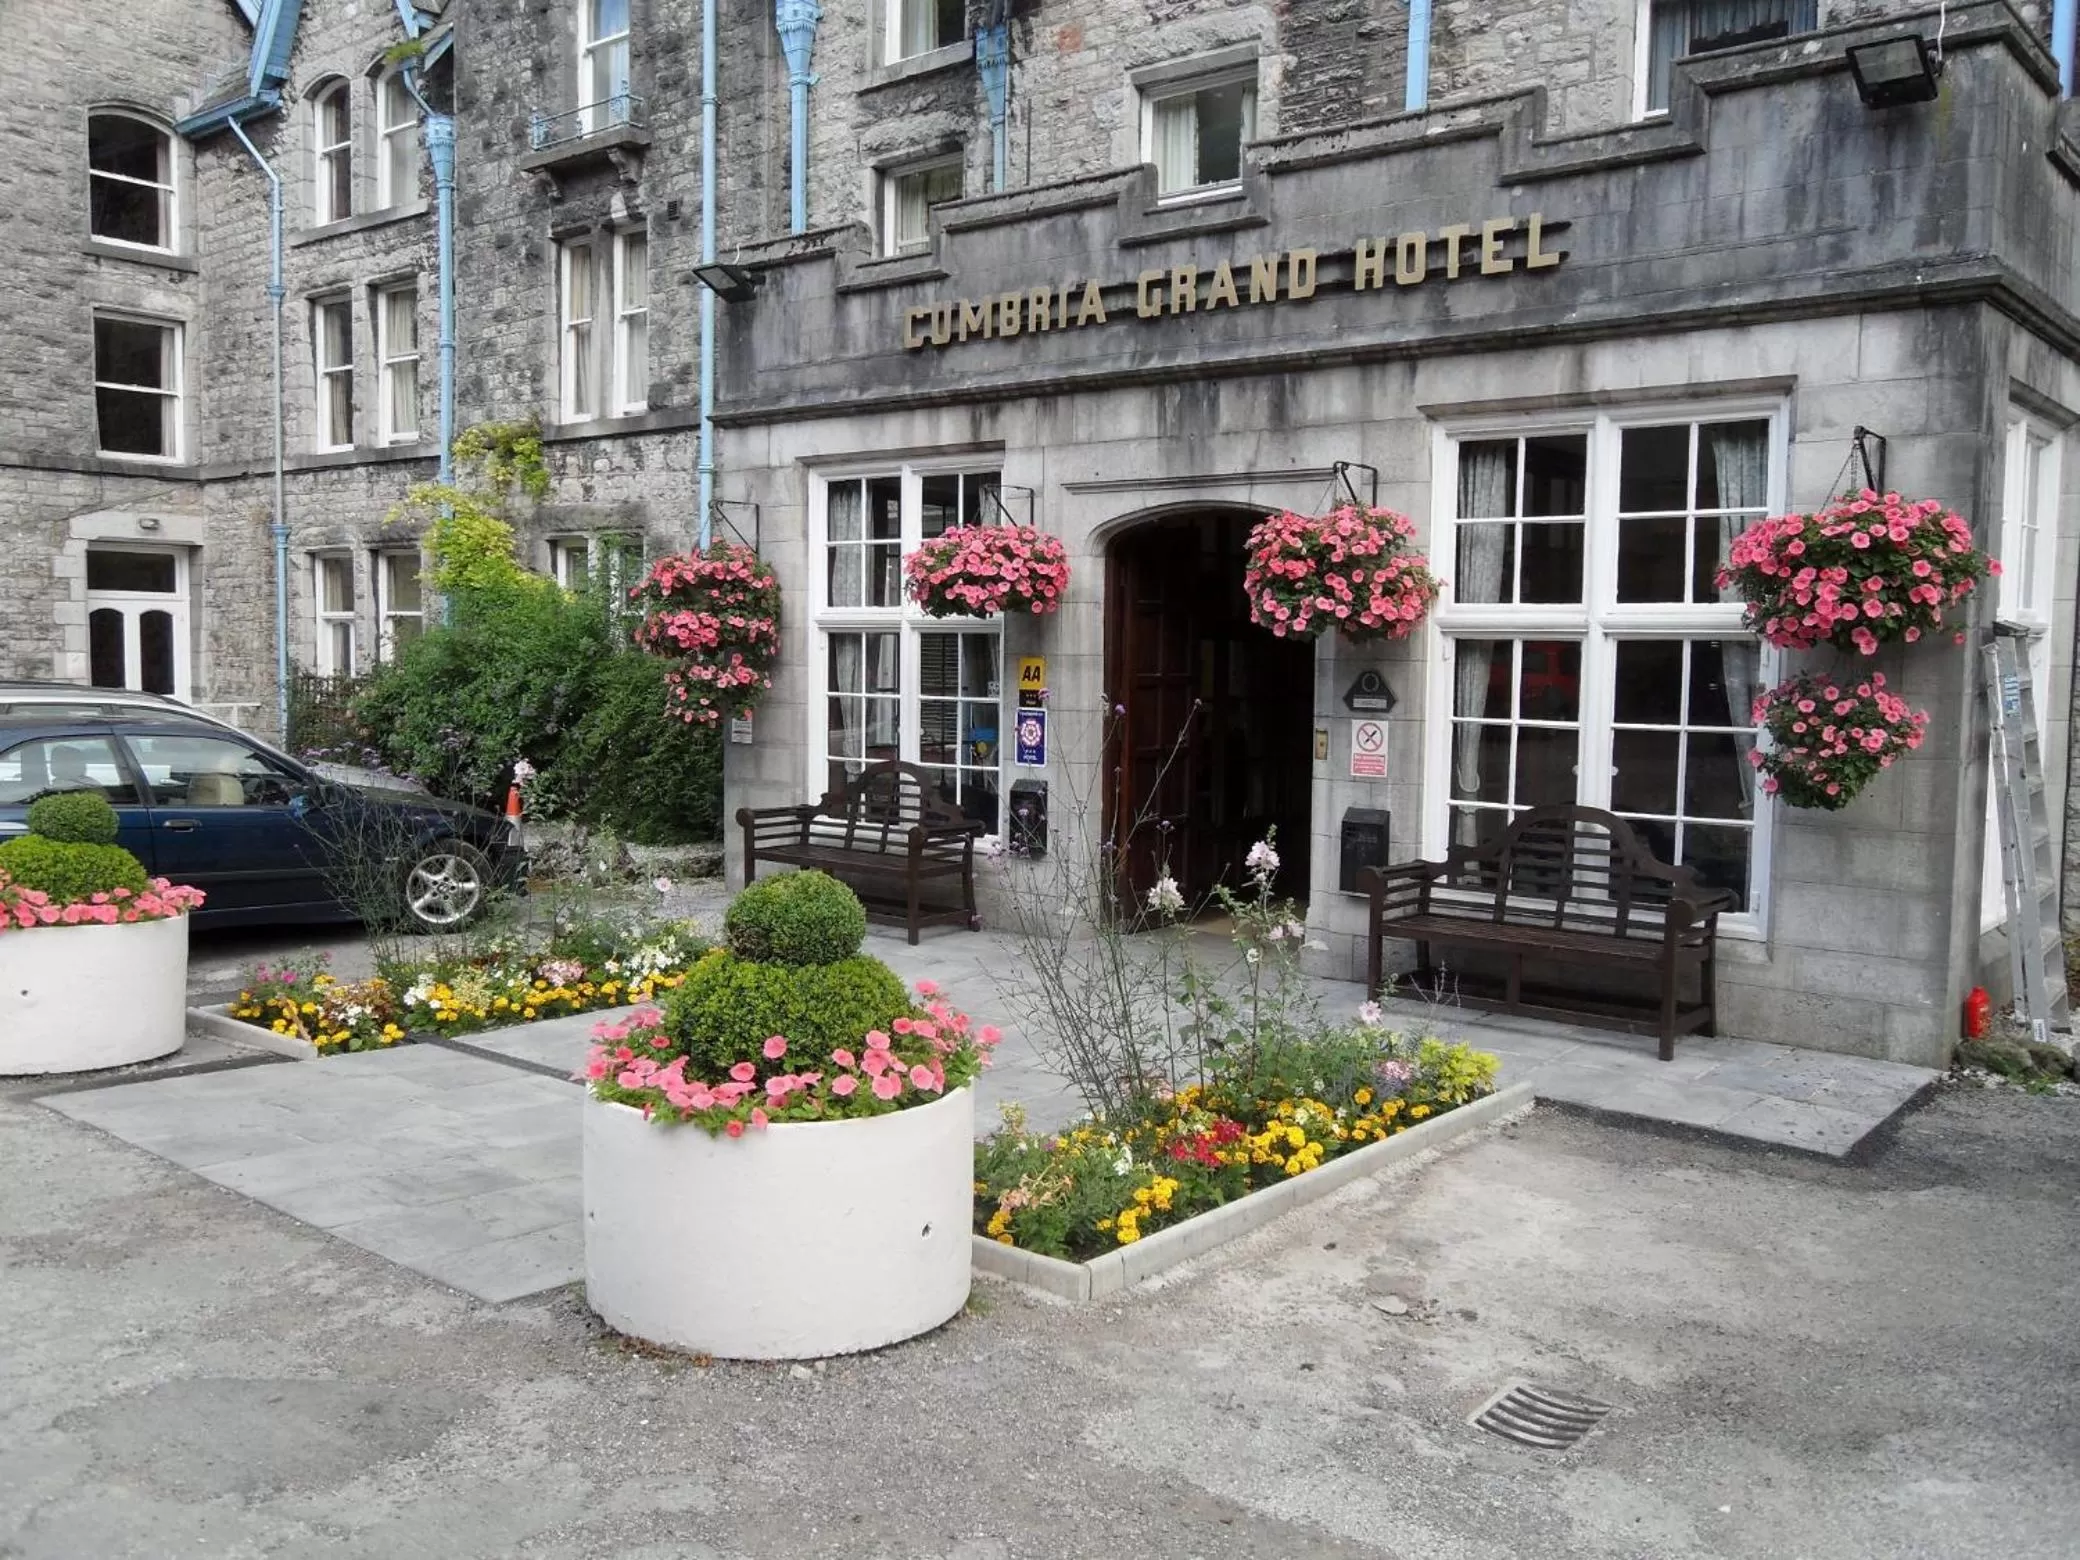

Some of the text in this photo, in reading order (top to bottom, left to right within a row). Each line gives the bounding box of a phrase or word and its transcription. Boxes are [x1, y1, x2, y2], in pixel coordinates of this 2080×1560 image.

[903, 212, 1561, 349] CUMBRIA GRAND HOTEL
[1022, 665, 1041, 682] AA
